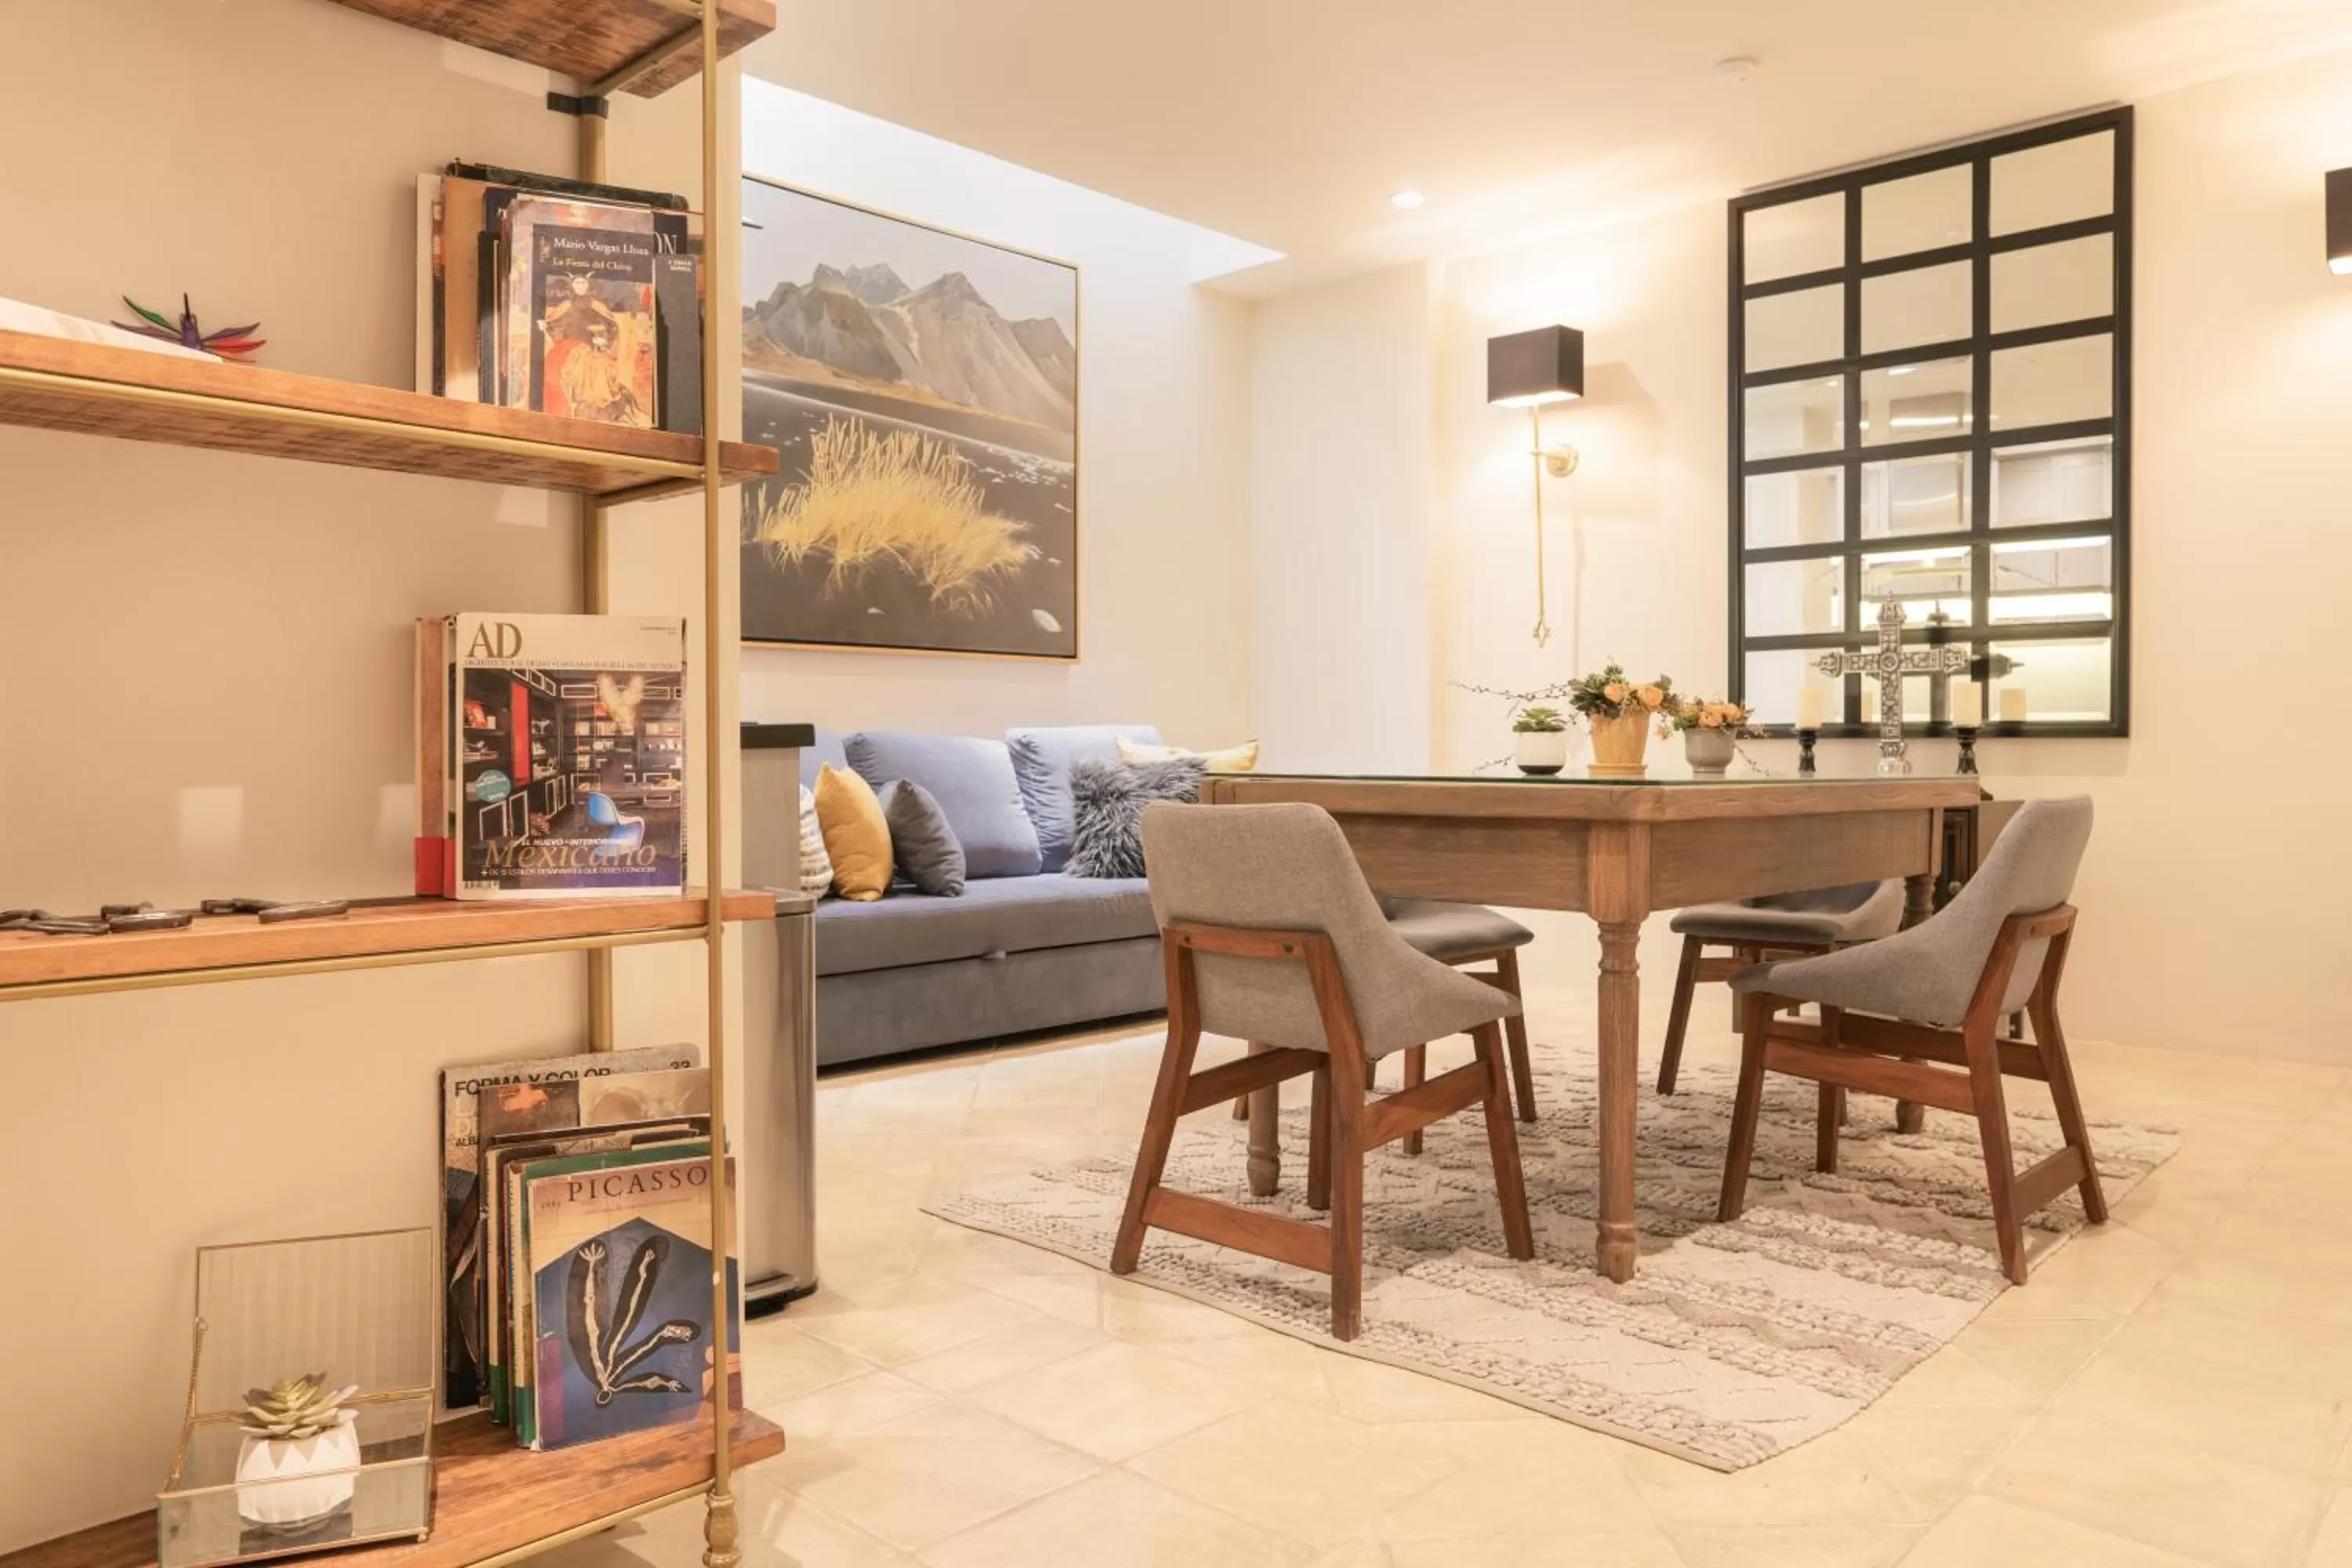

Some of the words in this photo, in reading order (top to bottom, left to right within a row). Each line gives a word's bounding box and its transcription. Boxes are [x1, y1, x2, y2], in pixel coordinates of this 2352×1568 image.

[553, 256, 564, 266] La
[554, 238, 586, 250] Mario
[587, 240, 620, 256] Vargas
[623, 244, 649, 256] Llosa
[465, 621, 522, 659] AD
[481, 840, 658, 868] Mexicano
[568, 1165, 708, 1202] PICASSO
